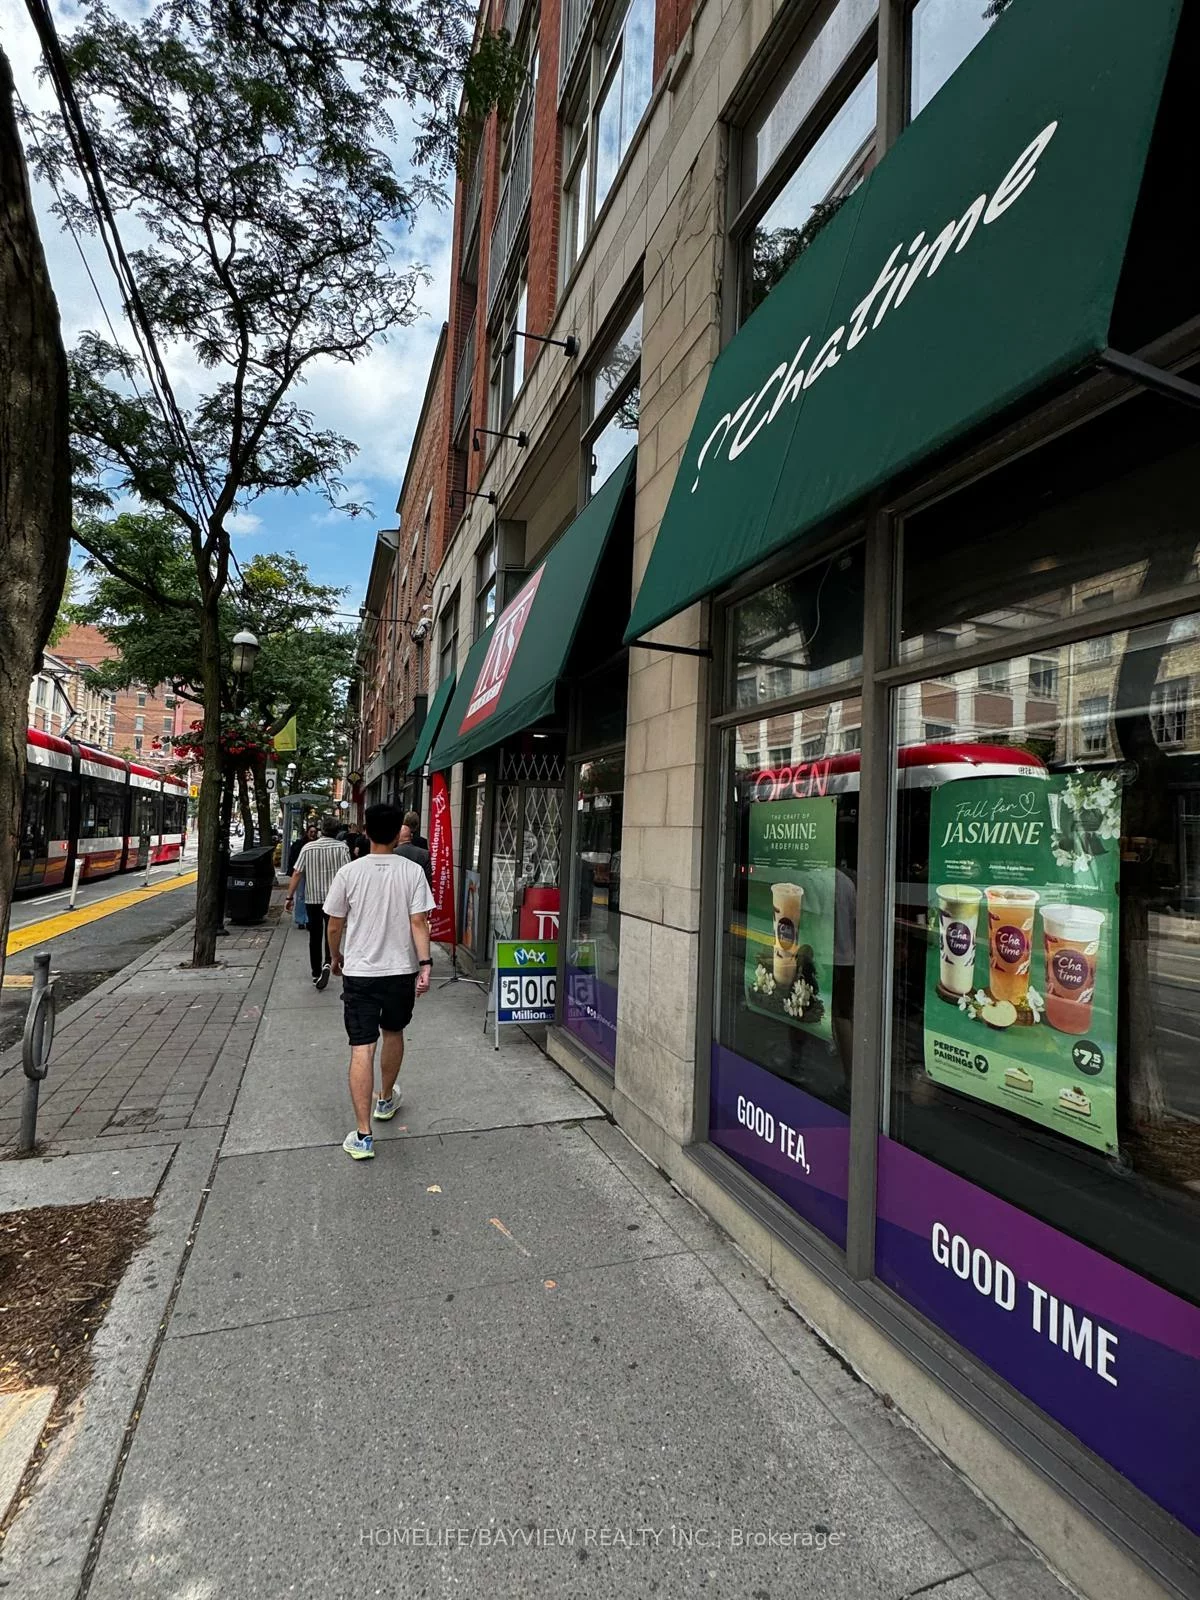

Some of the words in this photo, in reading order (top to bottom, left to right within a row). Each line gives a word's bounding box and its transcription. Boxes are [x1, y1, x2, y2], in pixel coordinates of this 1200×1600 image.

[692, 120, 1058, 493] Chatime
[755, 760, 831, 802] OPEN
[955, 800, 989, 821] Fall
[763, 822, 817, 840] JASMINE
[940, 821, 1044, 848] JASMINE
[949, 929, 968, 941] Cha
[999, 932, 1021, 946] Cha
[1000, 943, 1021, 957] time
[1056, 956, 1083, 972] Cha
[1057, 968, 1083, 984] time
[511, 1009, 546, 1020] Million
[934, 1039, 970, 1058] PERFECT
[934, 1049, 973, 1069] PAIRINGS
[737, 1095, 775, 1144] GOOD
[778, 1121, 811, 1175] TEA,
[932, 1222, 1016, 1312] GOOD
[1027, 1280, 1119, 1387] TIME
